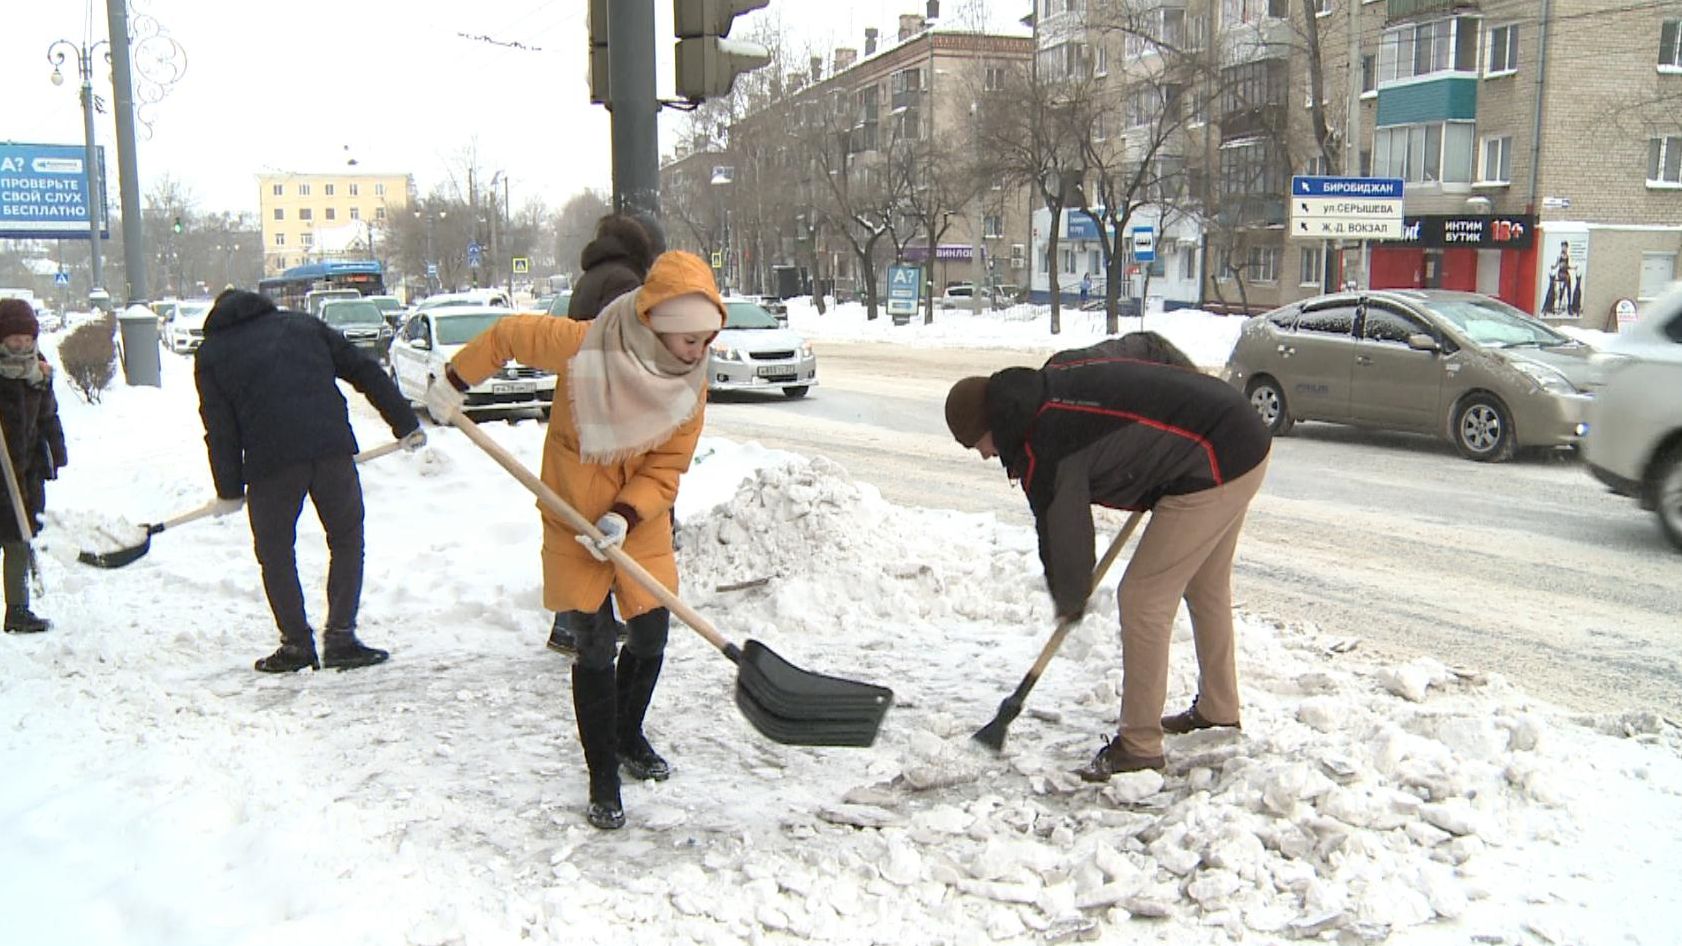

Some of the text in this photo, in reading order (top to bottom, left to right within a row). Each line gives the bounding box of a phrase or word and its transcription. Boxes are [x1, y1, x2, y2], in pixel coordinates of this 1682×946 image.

[1, 179, 78, 190] ПРОВЕРЬТЕ
[1323, 182, 1393, 195] БИРОБИДЖАН
[2, 190, 82, 203] СВОЙ СЛУХ
[3, 204, 86, 216] БЕСПЛАТНО
[1348, 223, 1388, 234] ВОКЗАЛ
[1445, 220, 1482, 231] ИНТИМ
[1492, 220, 1524, 241] 18+
[1445, 231, 1481, 242] БУТИК
